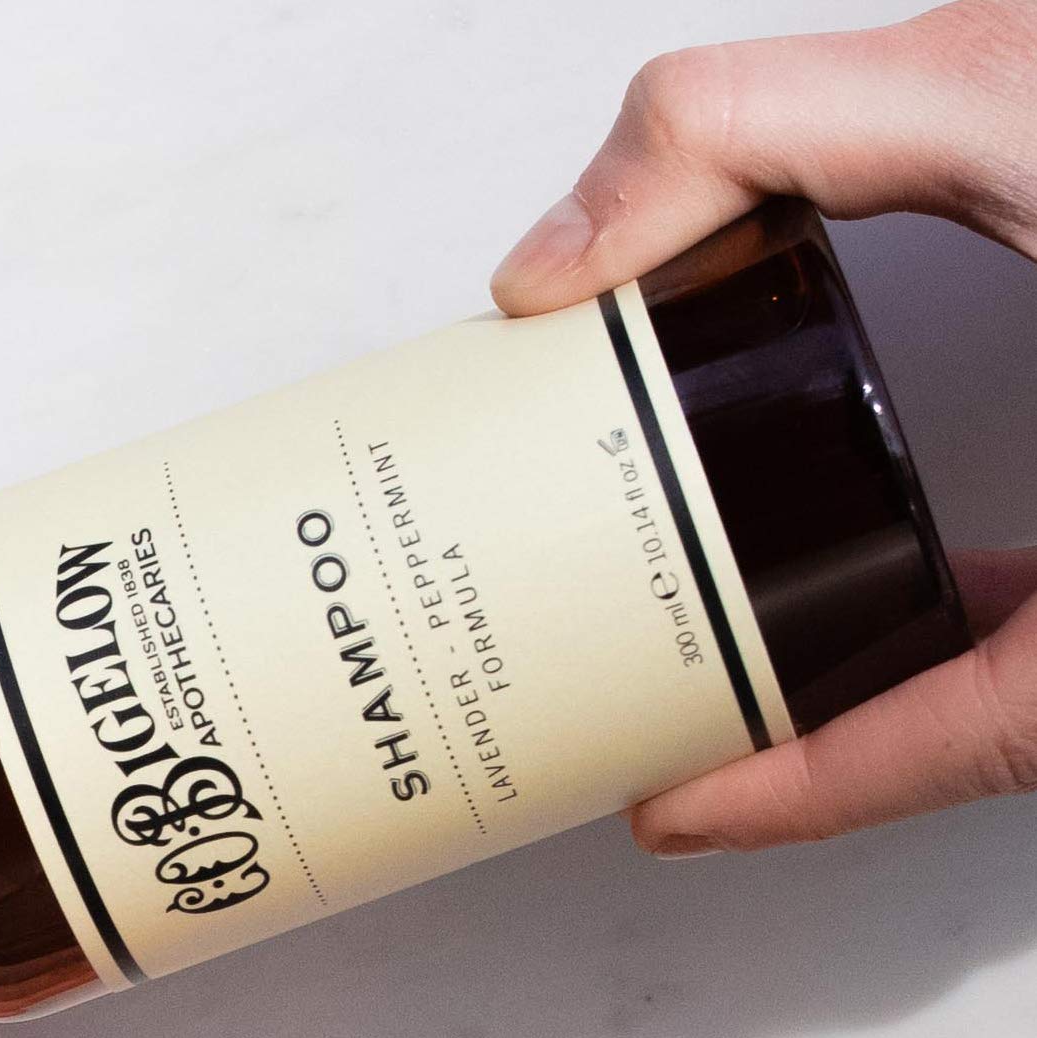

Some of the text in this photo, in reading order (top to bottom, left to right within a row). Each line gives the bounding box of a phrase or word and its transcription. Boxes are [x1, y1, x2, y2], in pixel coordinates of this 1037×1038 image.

[368, 441, 450, 629] PEPPERMINT
[619, 458, 638, 482] oz
[631, 505, 666, 564] 10.14
[117, 558, 184, 731] ESTABLISHED 1838
[131, 528, 222, 747] APOTHECARIES
[296, 508, 431, 801] SHAMPOO
[442, 543, 510, 692] FORMULA
[665, 602, 690, 626] ml
[675, 631, 703, 667] 300
[450, 670, 518, 803] LAVENDER
